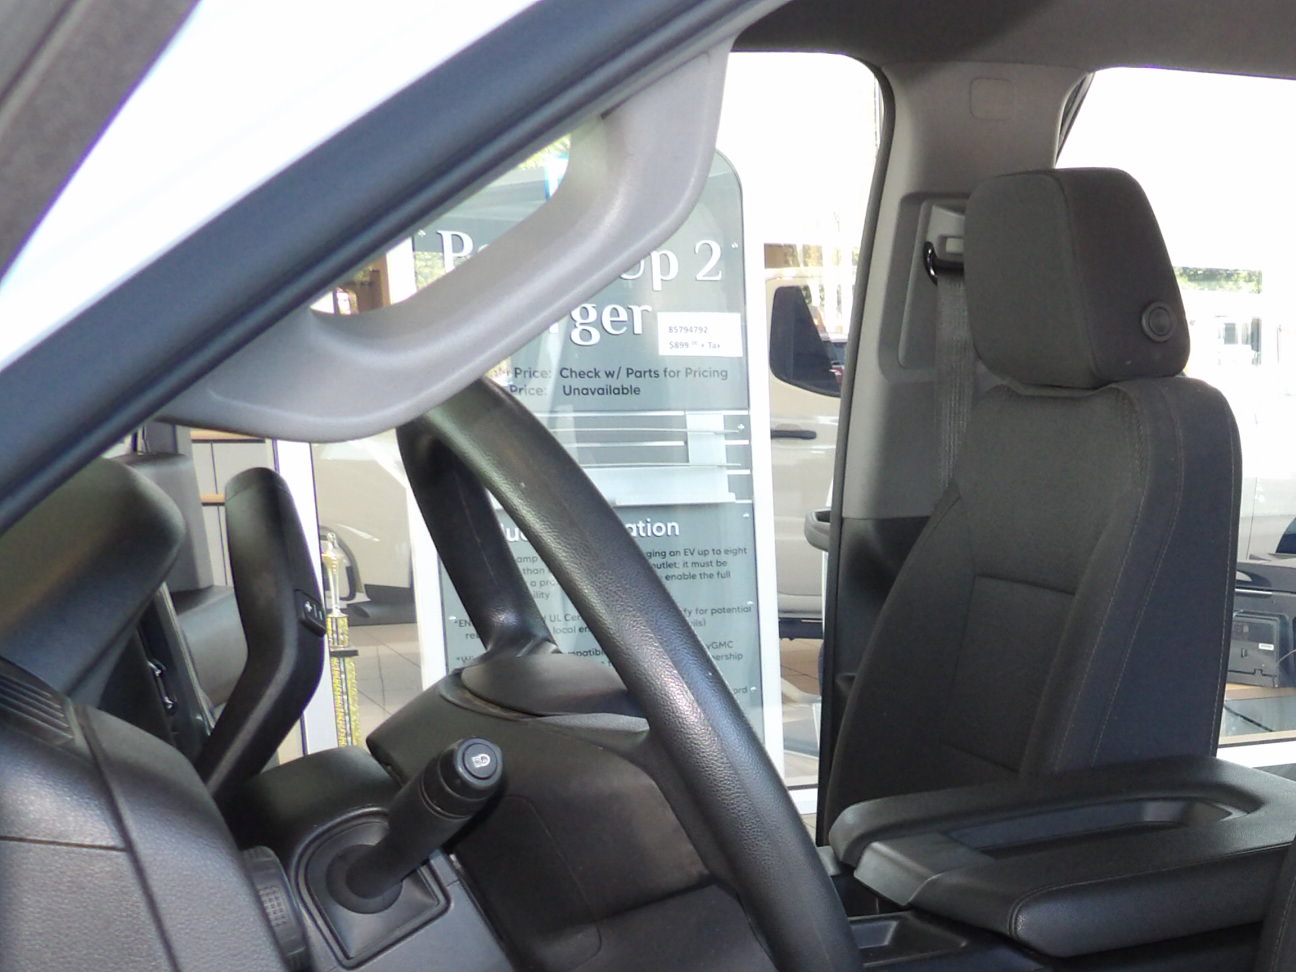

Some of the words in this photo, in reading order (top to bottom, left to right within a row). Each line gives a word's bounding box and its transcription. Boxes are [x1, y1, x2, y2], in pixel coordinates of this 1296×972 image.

[695, 240, 722, 281] 2
[560, 366, 601, 379] Check
[605, 366, 622, 379] w/
[626, 367, 660, 379] Parts
[663, 367, 681, 379] for
[685, 367, 729, 380] Pricing
[563, 383, 641, 396] Unavailable
[669, 550, 681, 558] an
[683, 548, 696, 556] EV
[698, 549, 710, 558] up
[712, 548, 721, 556] to
[724, 547, 747, 558] eight
[716, 560, 728, 568] be
[665, 572, 697, 581] enable
[699, 571, 714, 580] the
[717, 570, 731, 579] full
[696, 607, 708, 615] for
[711, 606, 752, 616] potential
